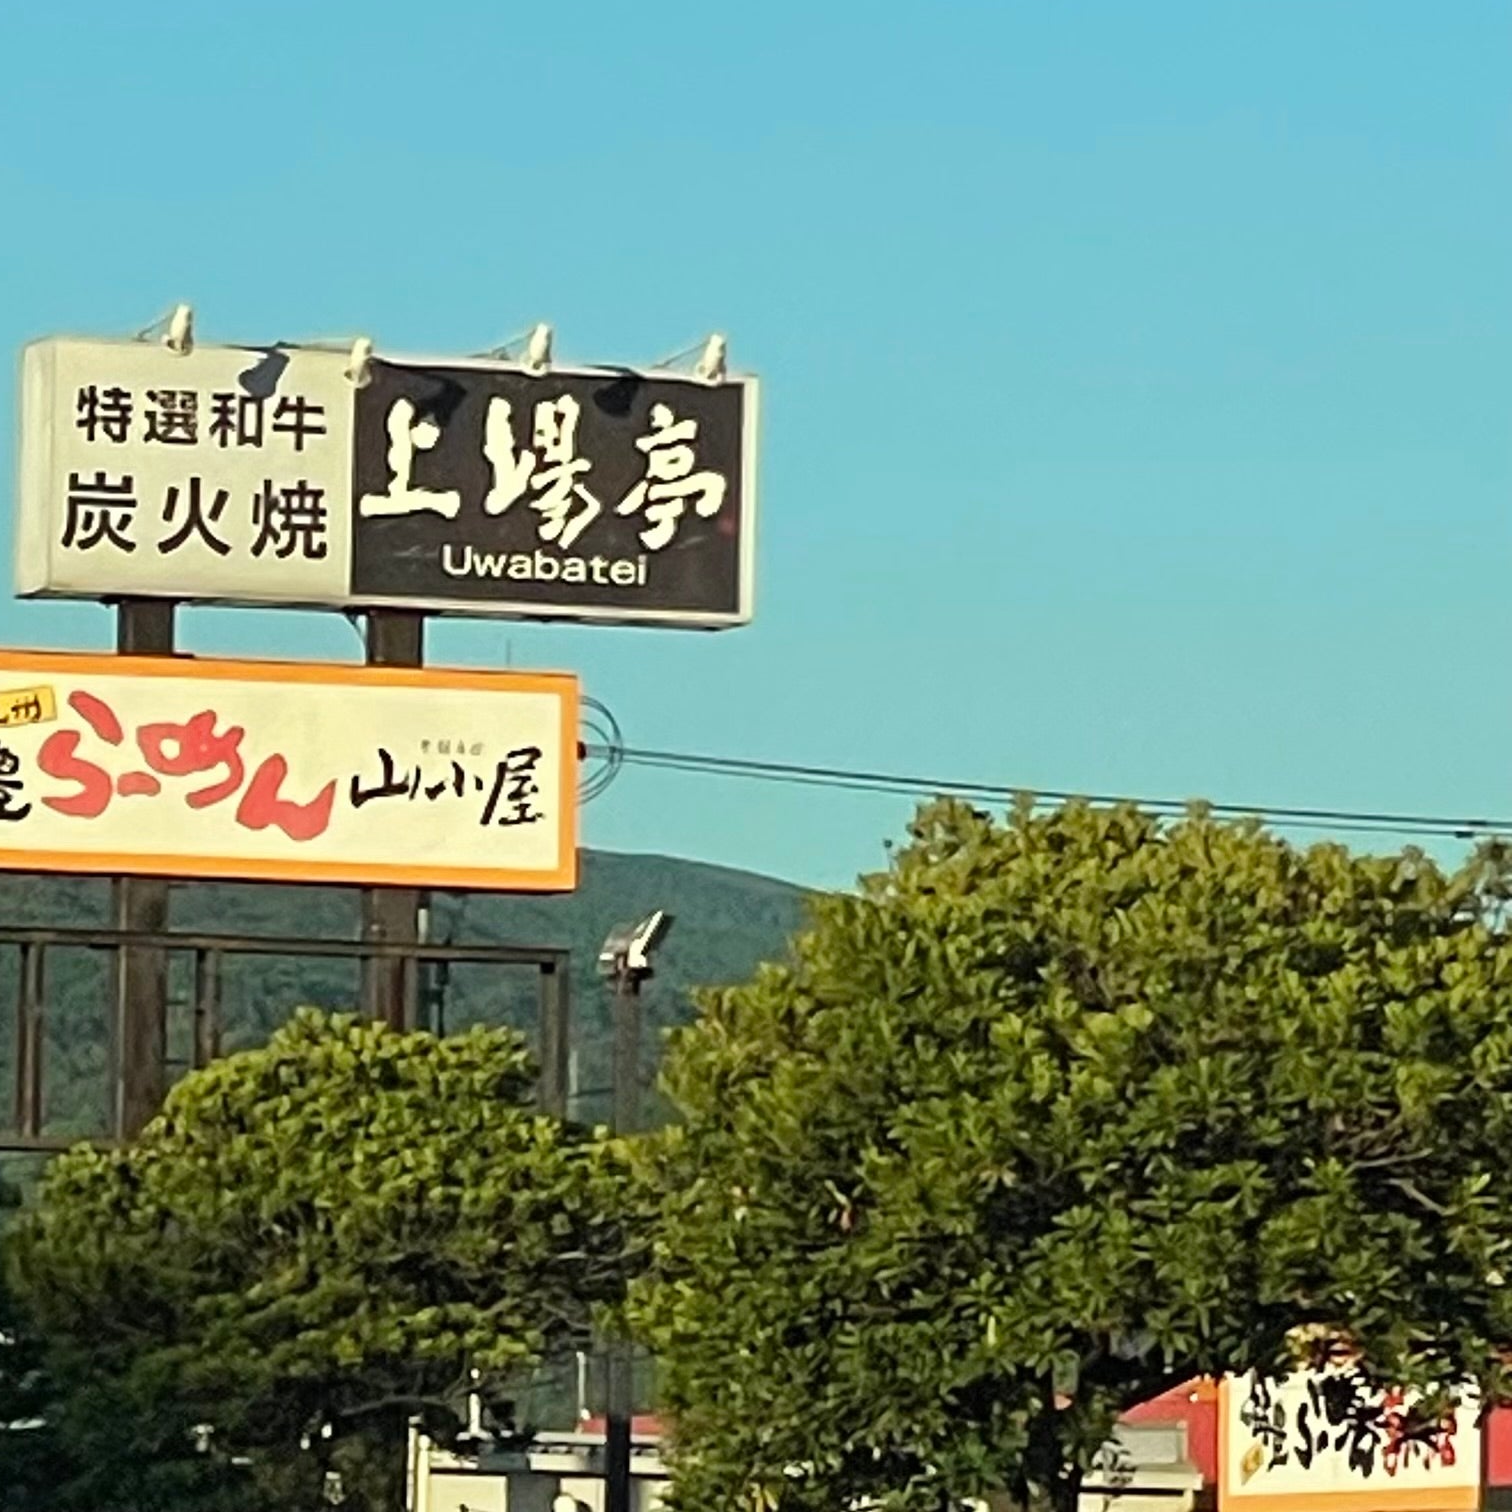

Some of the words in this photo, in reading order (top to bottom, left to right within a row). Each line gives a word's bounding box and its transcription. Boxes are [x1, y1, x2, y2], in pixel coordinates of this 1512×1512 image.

[76, 385, 327, 452] 特選和牛
[359, 392, 728, 552] 上場亭
[61, 471, 328, 560] 炭火焼
[440, 543, 649, 587] Uwabatei
[349, 746, 546, 827] 山小屋
